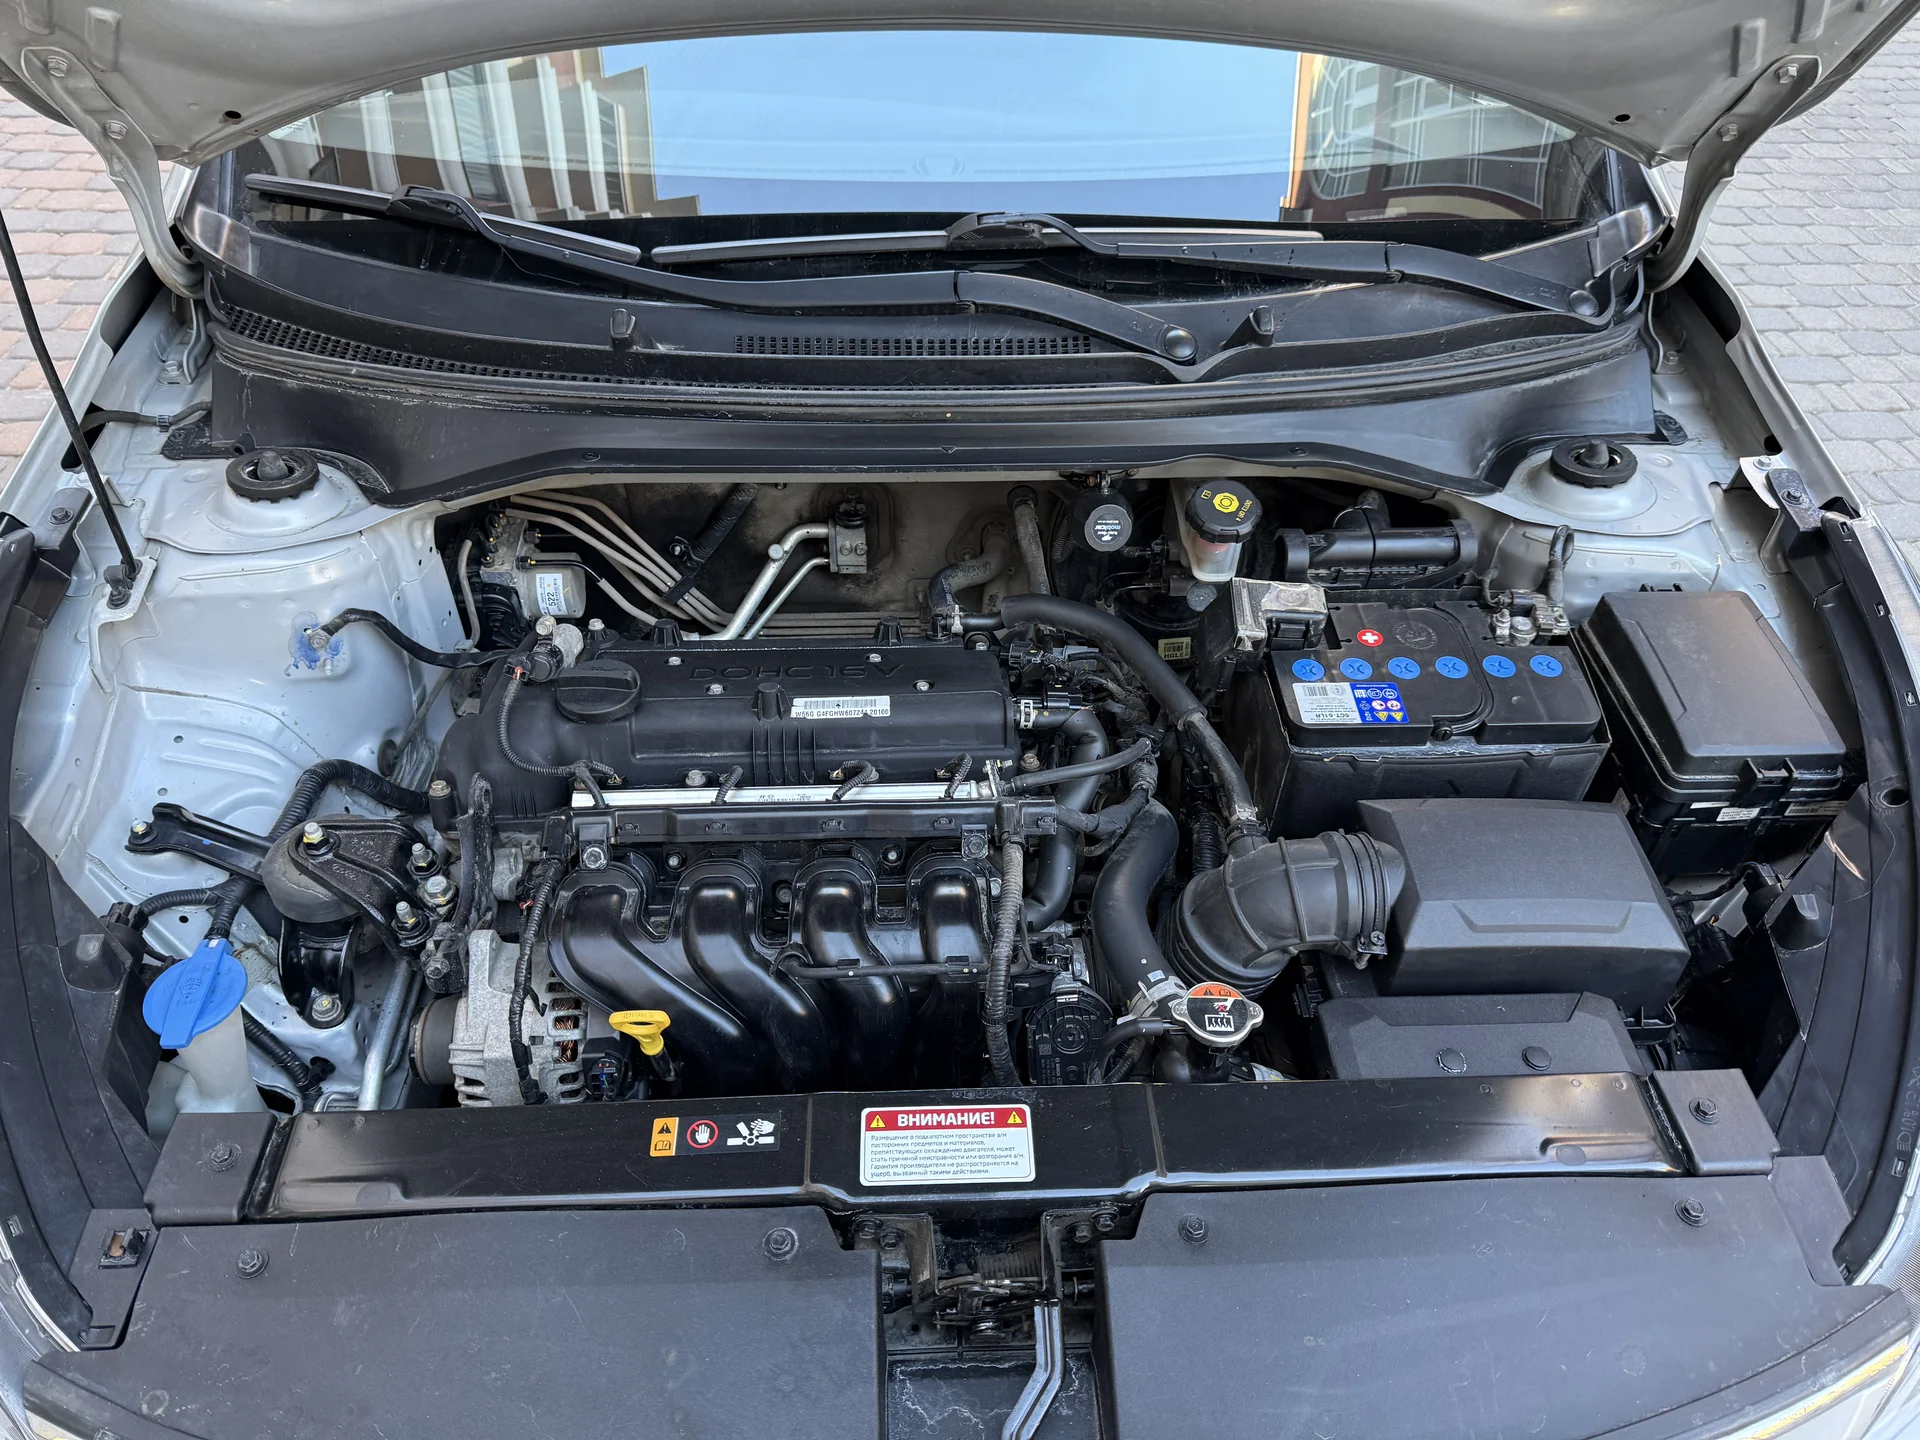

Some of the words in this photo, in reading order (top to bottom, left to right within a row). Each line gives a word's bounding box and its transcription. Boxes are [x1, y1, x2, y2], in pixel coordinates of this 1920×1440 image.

[546, 592, 556, 606] 522
[689, 665, 814, 680] DOHC
[824, 664, 904, 678] 16V
[897, 1112, 995, 1127] ВНИМАНИЕ!
